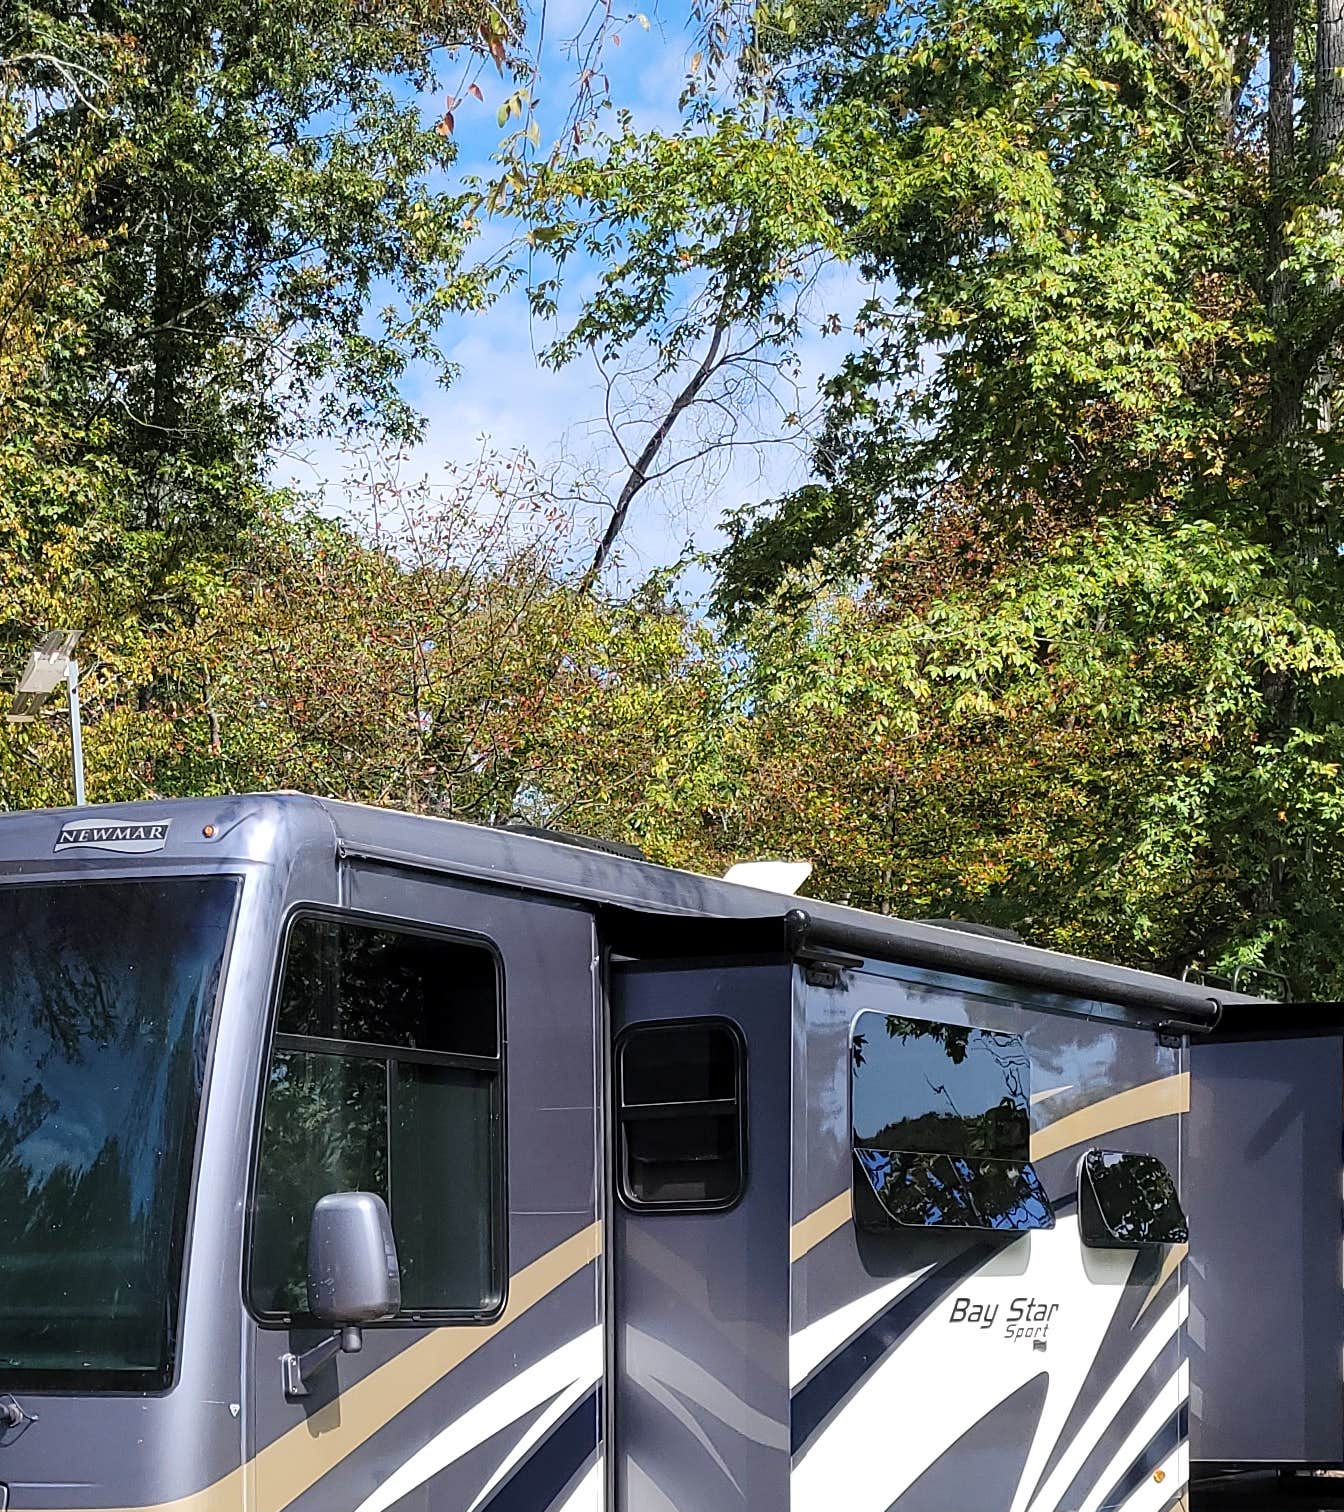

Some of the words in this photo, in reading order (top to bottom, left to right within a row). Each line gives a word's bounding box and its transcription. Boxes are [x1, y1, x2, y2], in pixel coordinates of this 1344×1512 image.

[59, 825, 164, 843] NEWMAR
[949, 1297, 999, 1329] Bay
[1006, 1297, 1059, 1322] Star
[1004, 1323, 1049, 1342] Sport
